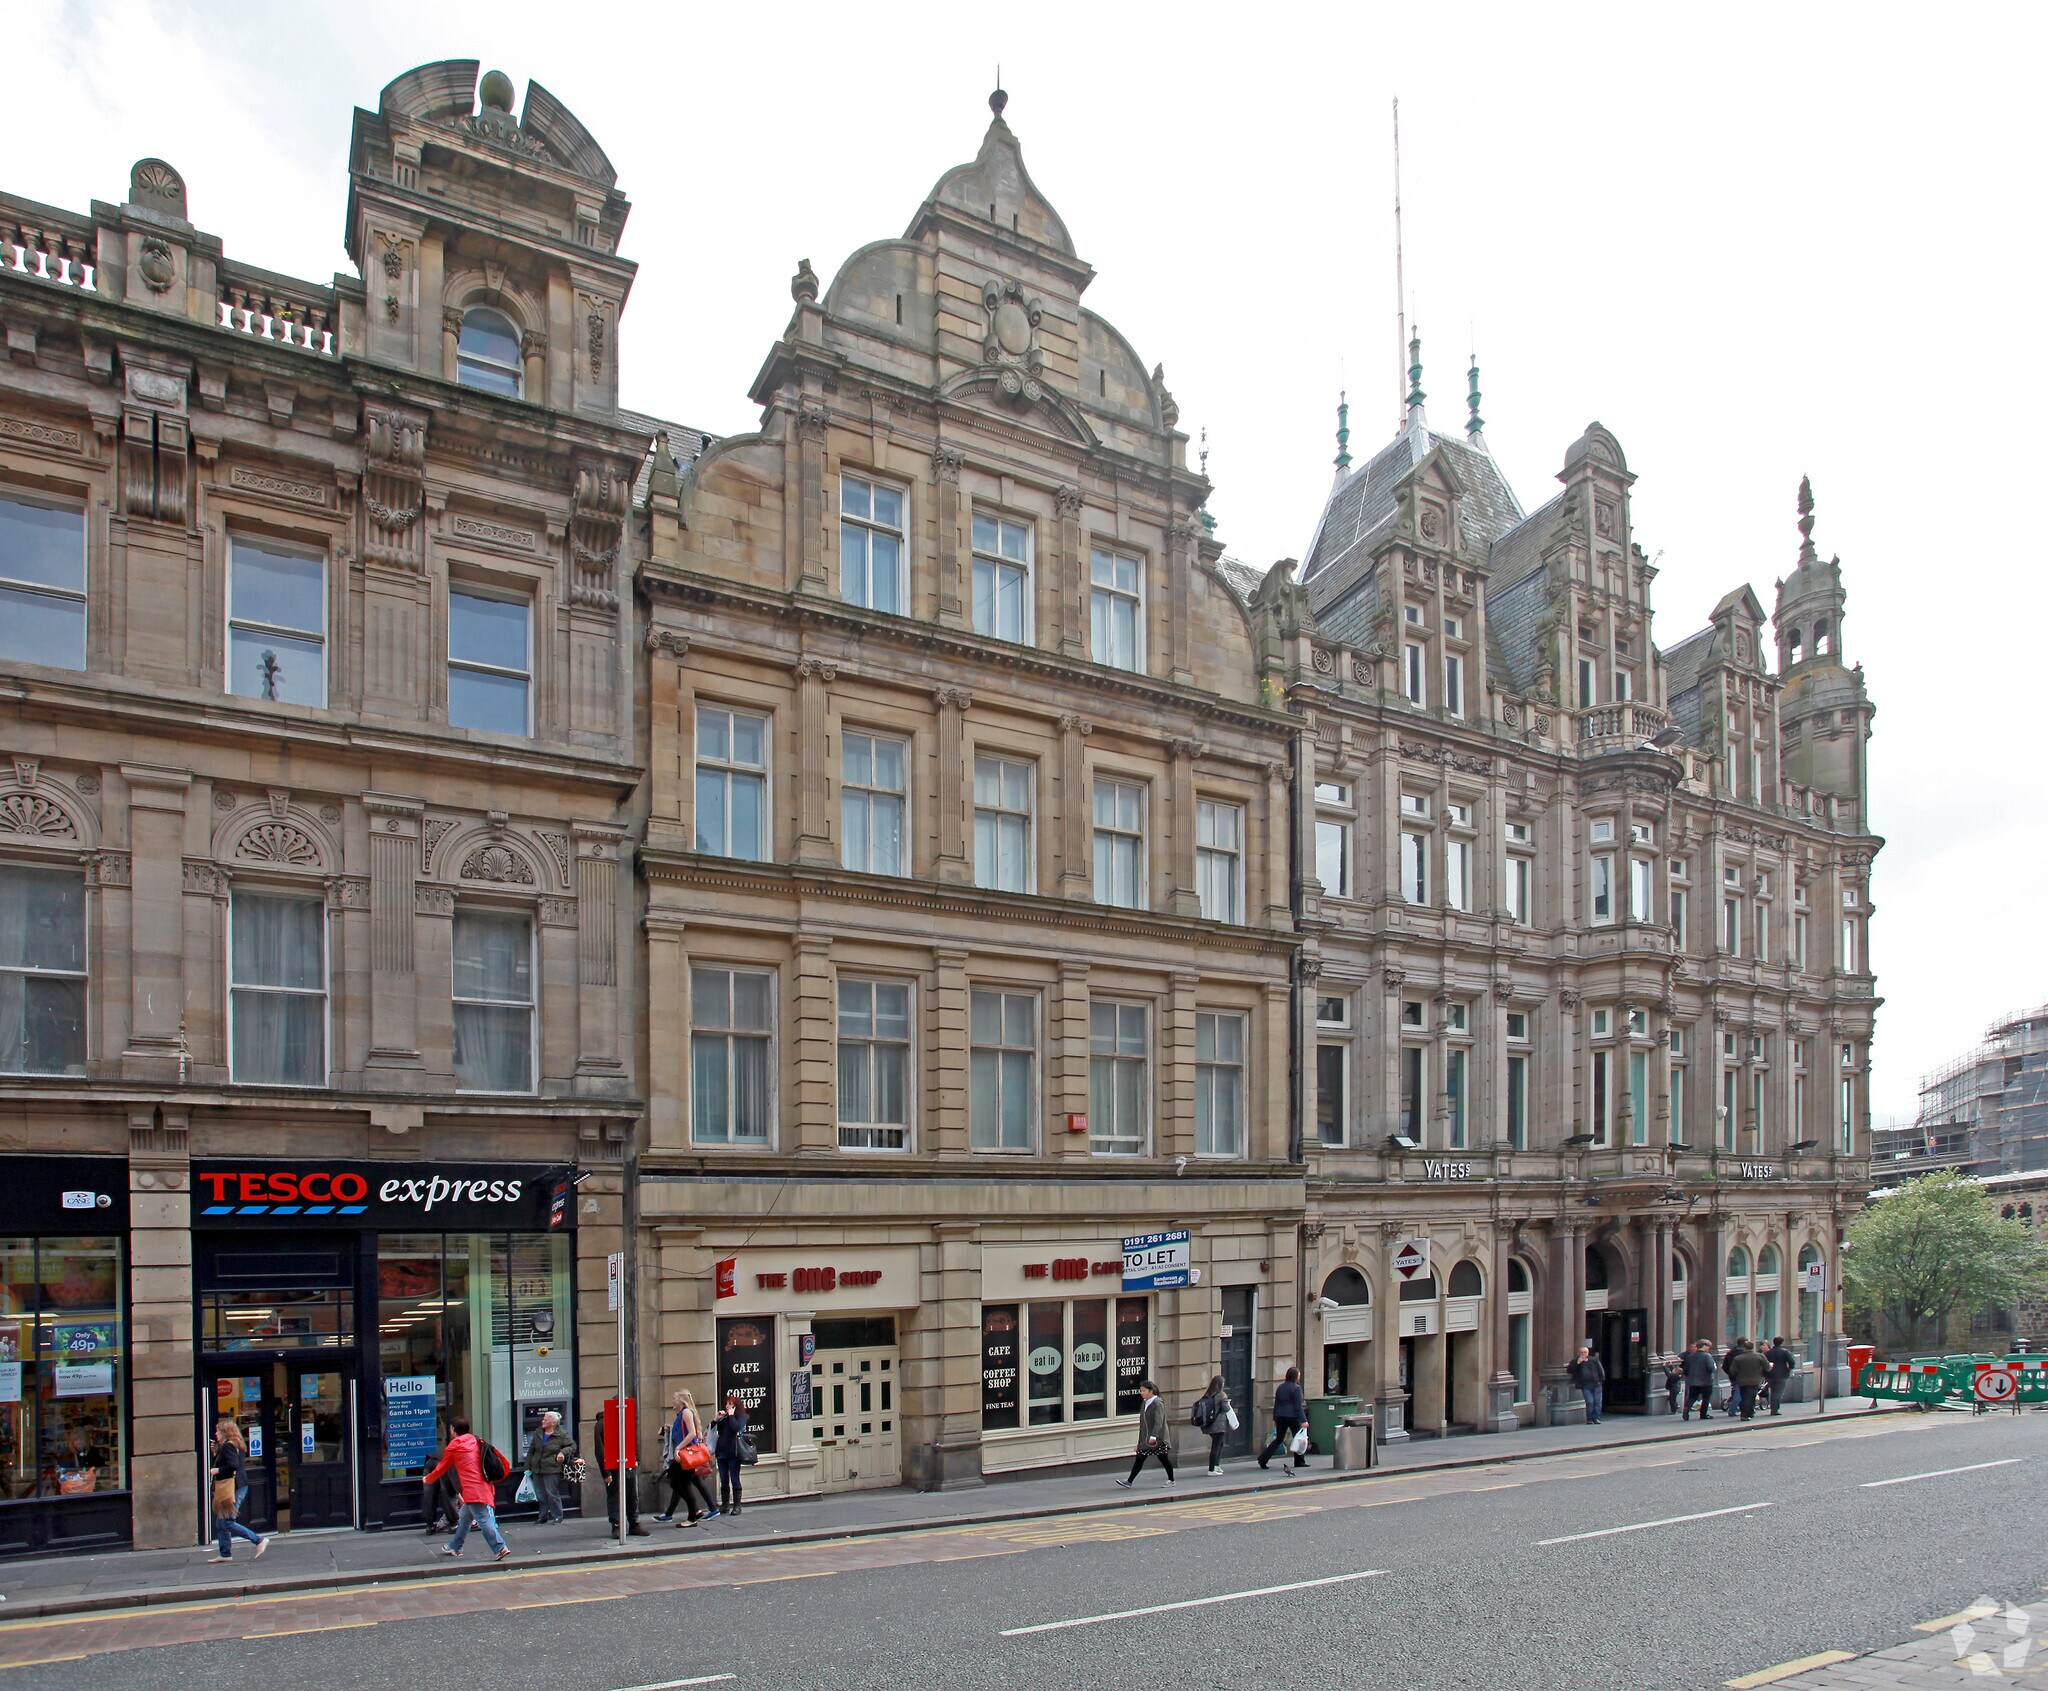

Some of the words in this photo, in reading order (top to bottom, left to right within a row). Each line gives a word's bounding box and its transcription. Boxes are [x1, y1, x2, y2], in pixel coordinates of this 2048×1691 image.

[200, 1172, 368, 1202] TESCO
[379, 1175, 521, 1212] express
[1124, 1237, 1144, 1246] 0191
[1147, 1234, 1163, 1243] 261
[1165, 1231, 1187, 1240] 2681
[1123, 1253, 1143, 1268] TO
[1147, 1249, 1176, 1265] LET
[1023, 1264, 1048, 1277] THE
[1091, 1261, 1125, 1275] CAFE
[756, 1273, 787, 1288] THE
[839, 1270, 882, 1286] SHOP
[70, 1339, 96, 1352] 49p
[1121, 1336, 1141, 1346] CAFE
[988, 1346, 1011, 1356] CAFE
[1074, 1353, 1090, 1363] take
[1091, 1351, 1103, 1361] out
[1034, 1356, 1046, 1367] eat
[1048, 1355, 1055, 1365] in
[1116, 1357, 1145, 1367] COFFEE
[732, 1362, 760, 1374] CAFE
[983, 1368, 1016, 1379] COFFEE
[1120, 1366, 1142, 1376] SHOP
[389, 1381, 422, 1393] Hello
[524, 1380, 541, 1388] Free
[543, 1378, 564, 1387] Cash
[988, 1378, 1011, 1389] SHOP
[519, 1388, 569, 1397] Withdrawals
[726, 1387, 767, 1398] COFFEE
